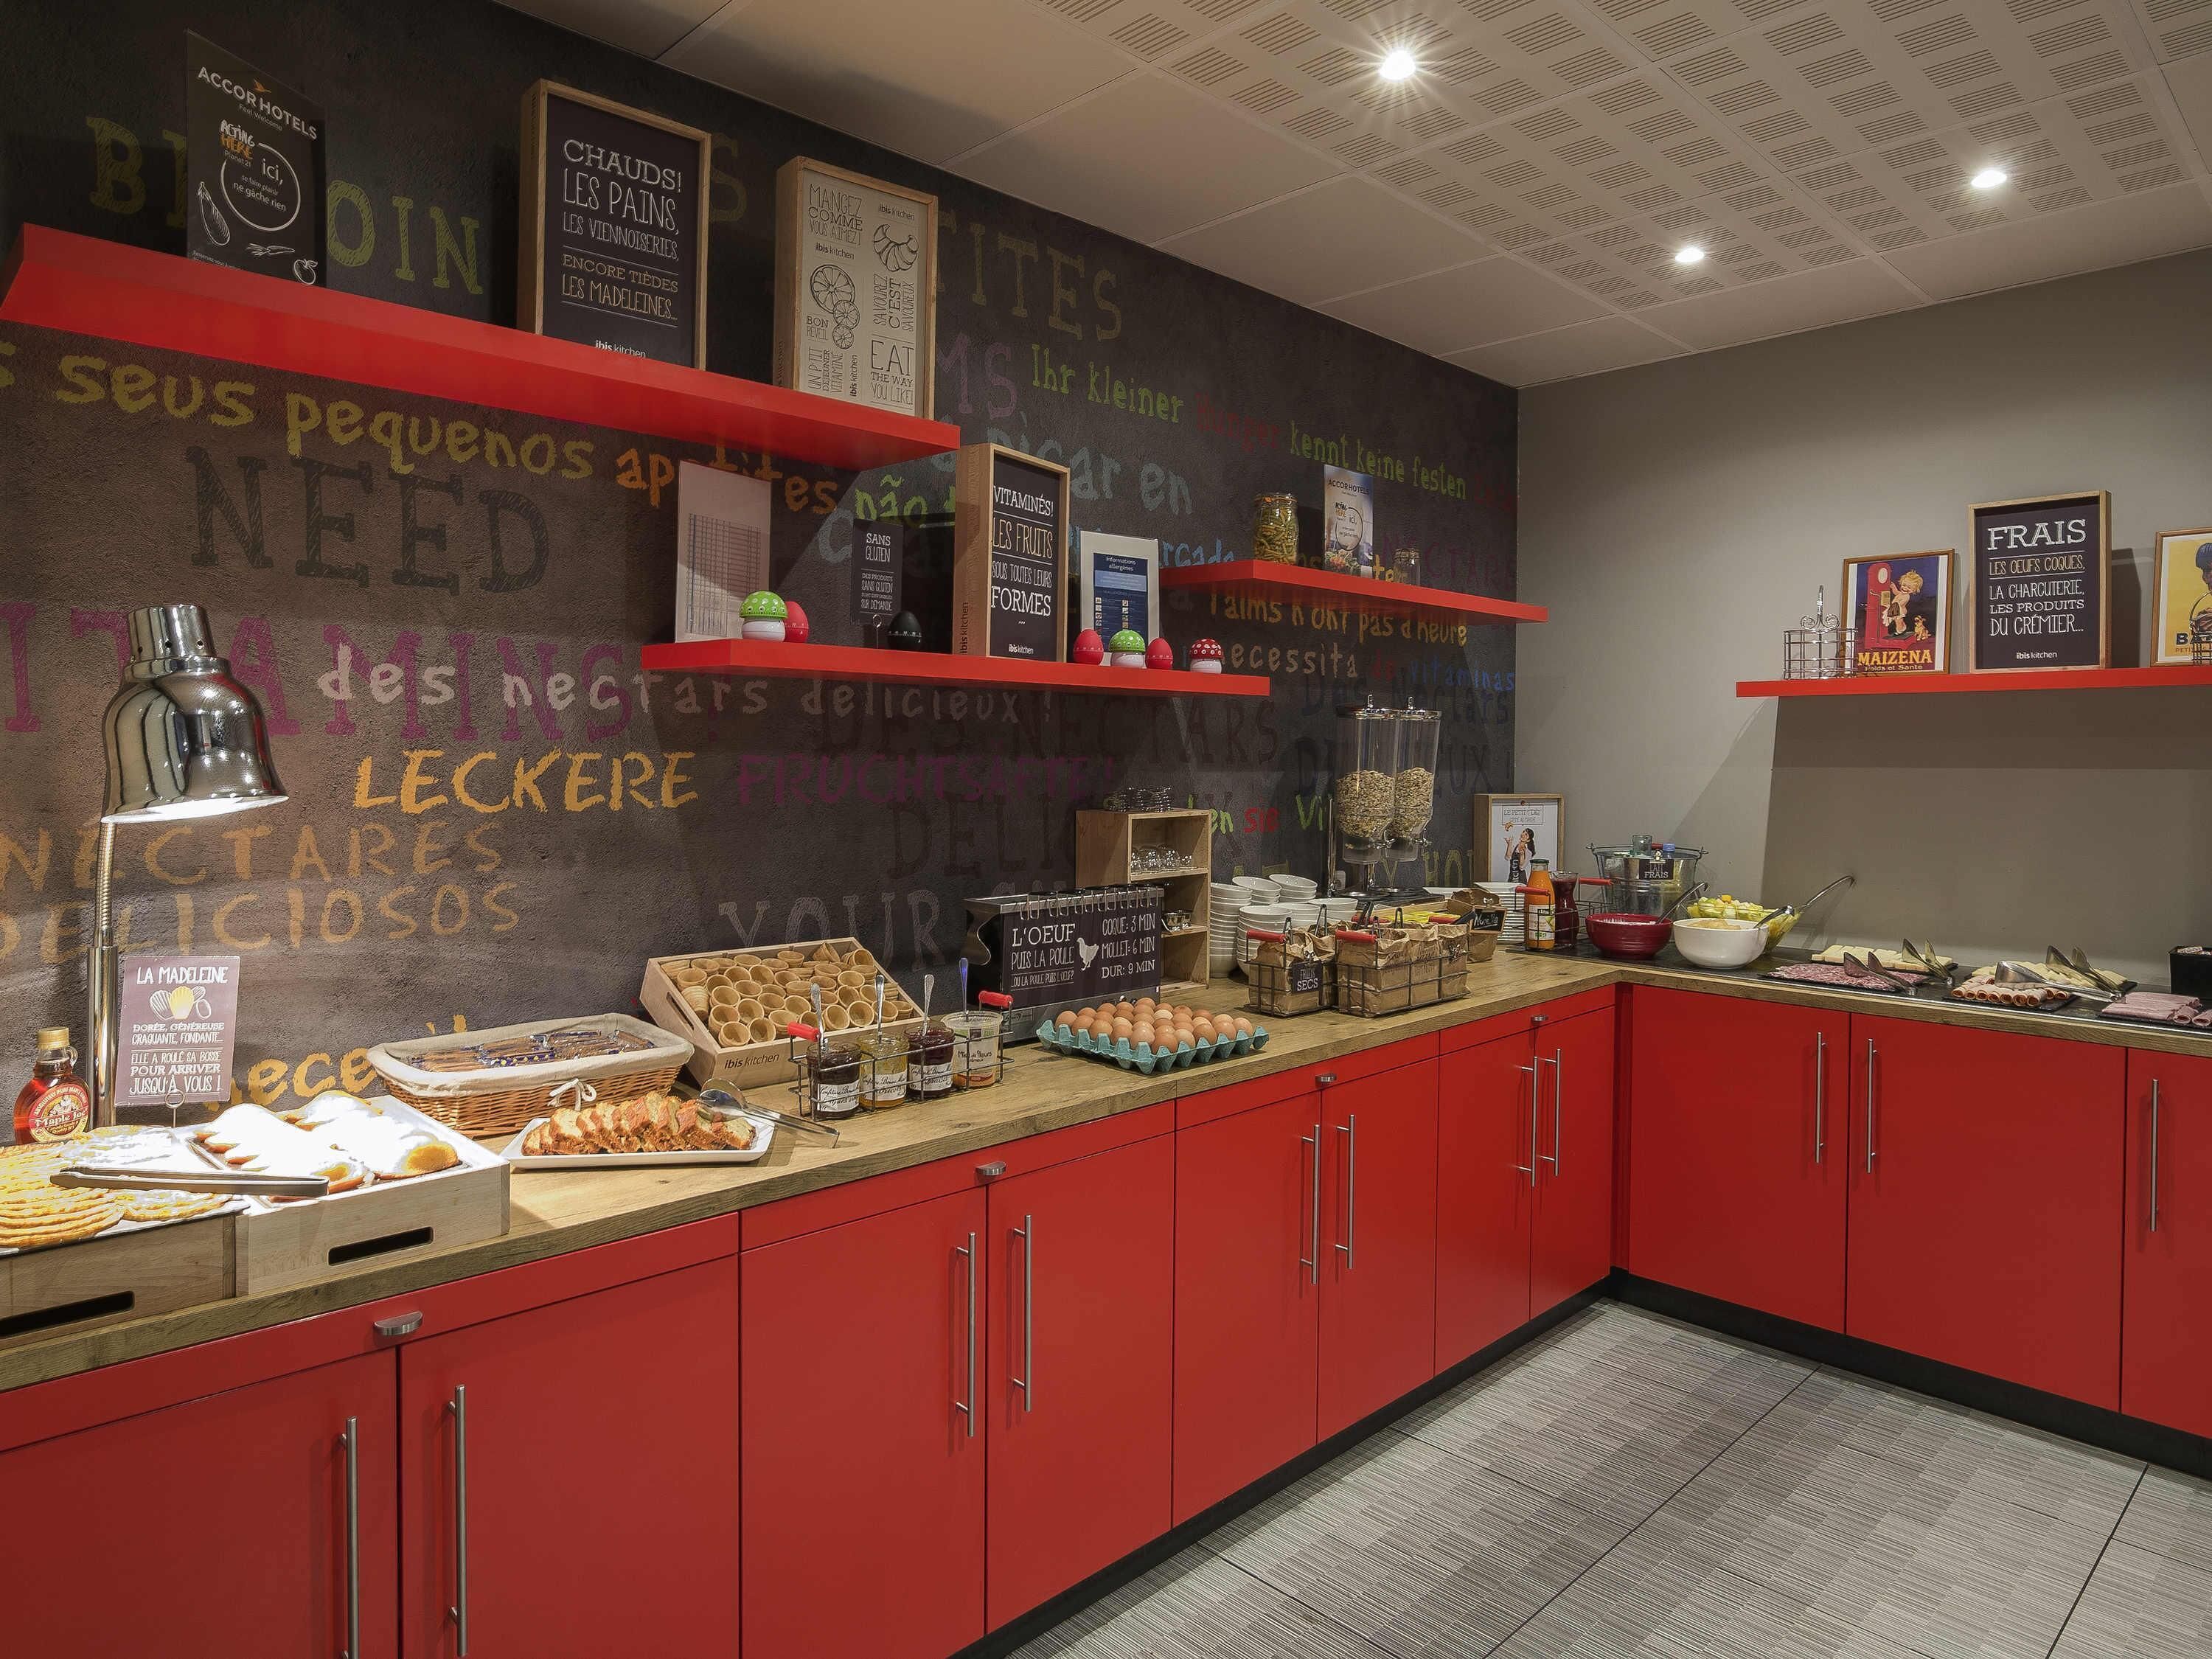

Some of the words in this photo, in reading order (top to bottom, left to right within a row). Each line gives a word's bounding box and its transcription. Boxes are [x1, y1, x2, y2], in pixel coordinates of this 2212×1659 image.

[262, 158, 283, 185] ici,
[563, 139, 682, 193] CHAUDS!
[246, 187, 271, 205] gâche
[271, 199, 287, 213] rien
[563, 168, 600, 211] LES
[609, 181, 680, 235] PAINS,
[809, 183, 863, 219] MANGEZ
[808, 206, 863, 232] COMME
[879, 203, 891, 214] ibis
[891, 205, 916, 221] kitchen
[563, 212, 584, 236] LES
[588, 218, 680, 262] VIENNOISERIES,
[809, 219, 829, 237] VOUS
[815, 242, 829, 254] ibis
[830, 247, 855, 260] kitchen
[563, 253, 626, 280] ENCORE
[629, 270, 678, 293] TIÈDES
[563, 274, 585, 299] LES
[888, 278, 902, 330] C'EST
[807, 315, 830, 329] BON
[849, 354, 858, 381] kitchen
[871, 339, 915, 377] EAT
[849, 381, 858, 397] ibis
[871, 371, 890, 383] THE
[891, 376, 914, 389] WAY
[871, 383, 888, 400] YOU
[1032, 344, 1077, 394] Ihr
[1087, 361, 1186, 425] kleiner
[1290, 418, 1350, 469] kennt
[1355, 437, 1405, 484] keine
[1410, 454, 1468, 501] festen
[992, 485, 1054, 518] VITAMINÉS!
[184, 445, 550, 597] NEED
[866, 532, 891, 546] SANS
[992, 517, 1012, 550] LES
[1016, 523, 1053, 560] FRUITS
[1987, 518, 2087, 550] FRAIS
[866, 546, 891, 563] GLUTEN
[1989, 560, 2006, 576] LES
[2010, 557, 2041, 574] OEUFS
[2045, 554, 2085, 571] COQUES,
[992, 560, 1008, 580] SOUS
[1010, 563, 1032, 585] TOUTES
[1034, 567, 1052, 589] LEURS
[861, 580, 874, 592] SANS
[875, 581, 893, 593] GLUTEN
[1989, 585, 2005, 600] LA
[2008, 579, 2084, 599] CHARCUTERIE,
[860, 599, 869, 610] SUR
[870, 599, 893, 611] DEMANDE
[991, 585, 1051, 617] FORMES
[1990, 603, 2014, 614] LES
[2017, 599, 2085, 613] PRODUITS
[961, 602, 970, 637] kitchen
[1990, 617, 2008, 636] DU
[960, 637, 968, 654] ibis
[1008, 644, 1018, 653] ibis
[1018, 644, 1034, 655] kitchen
[2017, 652, 2031, 660] ibis
[2031, 651, 2058, 659] kitchen
[1858, 649, 1933, 667] MAIZENA
[317, 641, 456, 705] des
[353, 747, 699, 815] LECKERE
[1012, 923, 1076, 947] L'OEUF
[1102, 917, 1129, 936] COQUE:
[1130, 915, 1136, 933] 3
[1138, 913, 1155, 931] MIN
[1011, 951, 1032, 970] PUIS
[1034, 949, 1046, 968] LA
[1049, 946, 1074, 967] POULE
[1102, 939, 1131, 960] MOLLET:
[1133, 939, 1138, 955] 6
[1139, 936, 1155, 954] MIN
[136, 967, 154, 985] LA
[158, 967, 229, 985] MADELEINE
[1102, 965, 1125, 979] DUR:
[1127, 962, 1134, 974] 9
[1135, 959, 1156, 974] MIN
[1297, 978, 1318, 992] SECS
[133, 1022, 168, 1033] DORÉE,
[170, 1022, 225, 1032] GÉNÉREUSE
[131, 1053, 149, 1065] ELLE
[152, 1053, 159, 1064] A
[161, 1051, 185, 1064] ROULÉ
[187, 1051, 197, 1062] SA
[200, 1051, 222, 1062] BOSSE
[724, 1058, 743, 1069] ibis
[744, 1054, 779, 1067] kitchen
[130, 1065, 166, 1077] POUR
[169, 1063, 220, 1075] ARRIVER
[184, 1076, 212, 1093] VOUS
[34, 1113, 72, 1128] Maple
[72, 1107, 88, 1119] Joe
